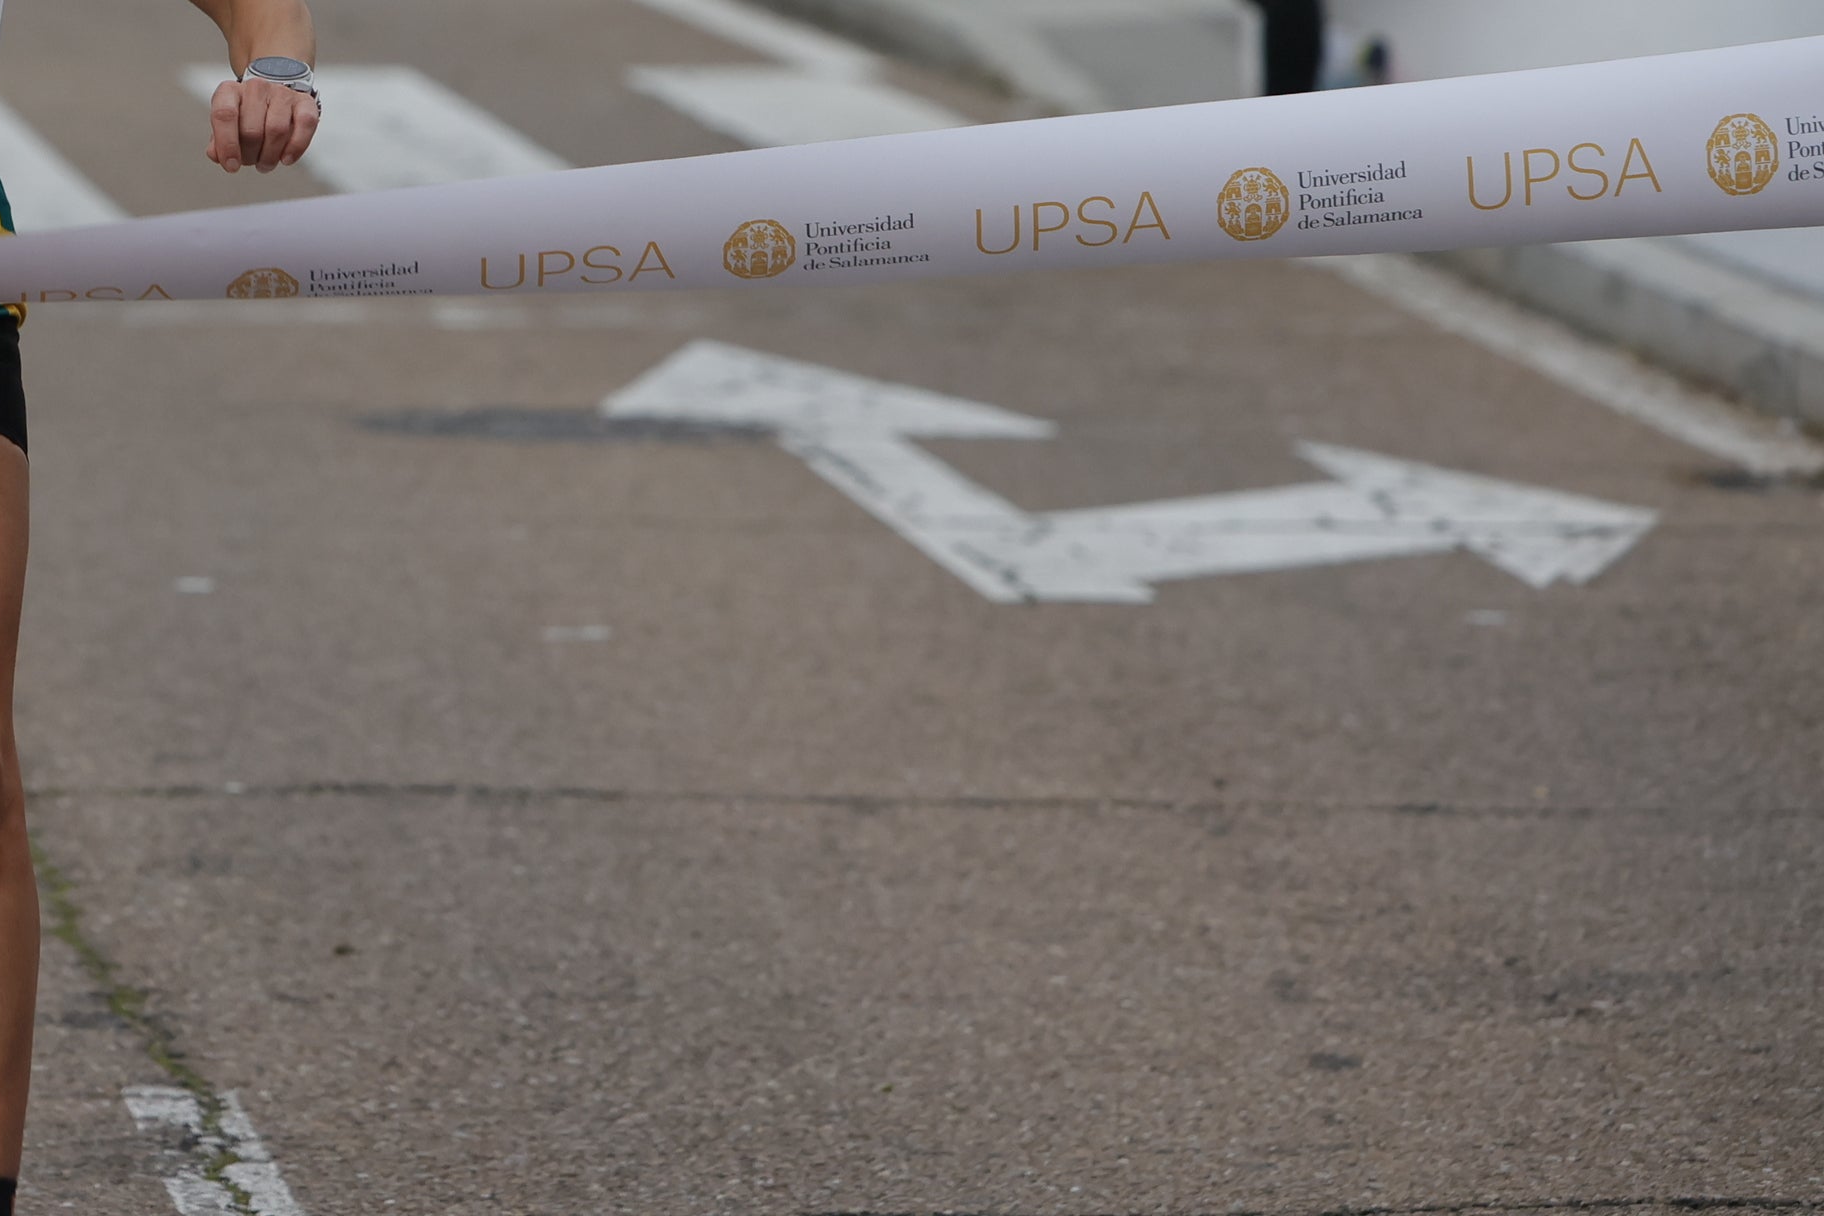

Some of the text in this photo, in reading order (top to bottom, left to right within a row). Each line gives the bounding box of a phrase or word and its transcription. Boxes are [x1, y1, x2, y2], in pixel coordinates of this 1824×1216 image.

[1297, 160, 1407, 189] Universidad
[1466, 137, 1663, 210] UPSA
[1788, 164, 1811, 182] de
[1299, 187, 1384, 211] Pontificia
[805, 213, 915, 239] Universidad
[975, 191, 1171, 255] UPSA
[1297, 208, 1423, 230] de Salamanca
[805, 236, 892, 257] Pontificia
[309, 260, 419, 283] Universidad
[479, 241, 676, 290] UPSA
[803, 253, 931, 271] de Salamanca
